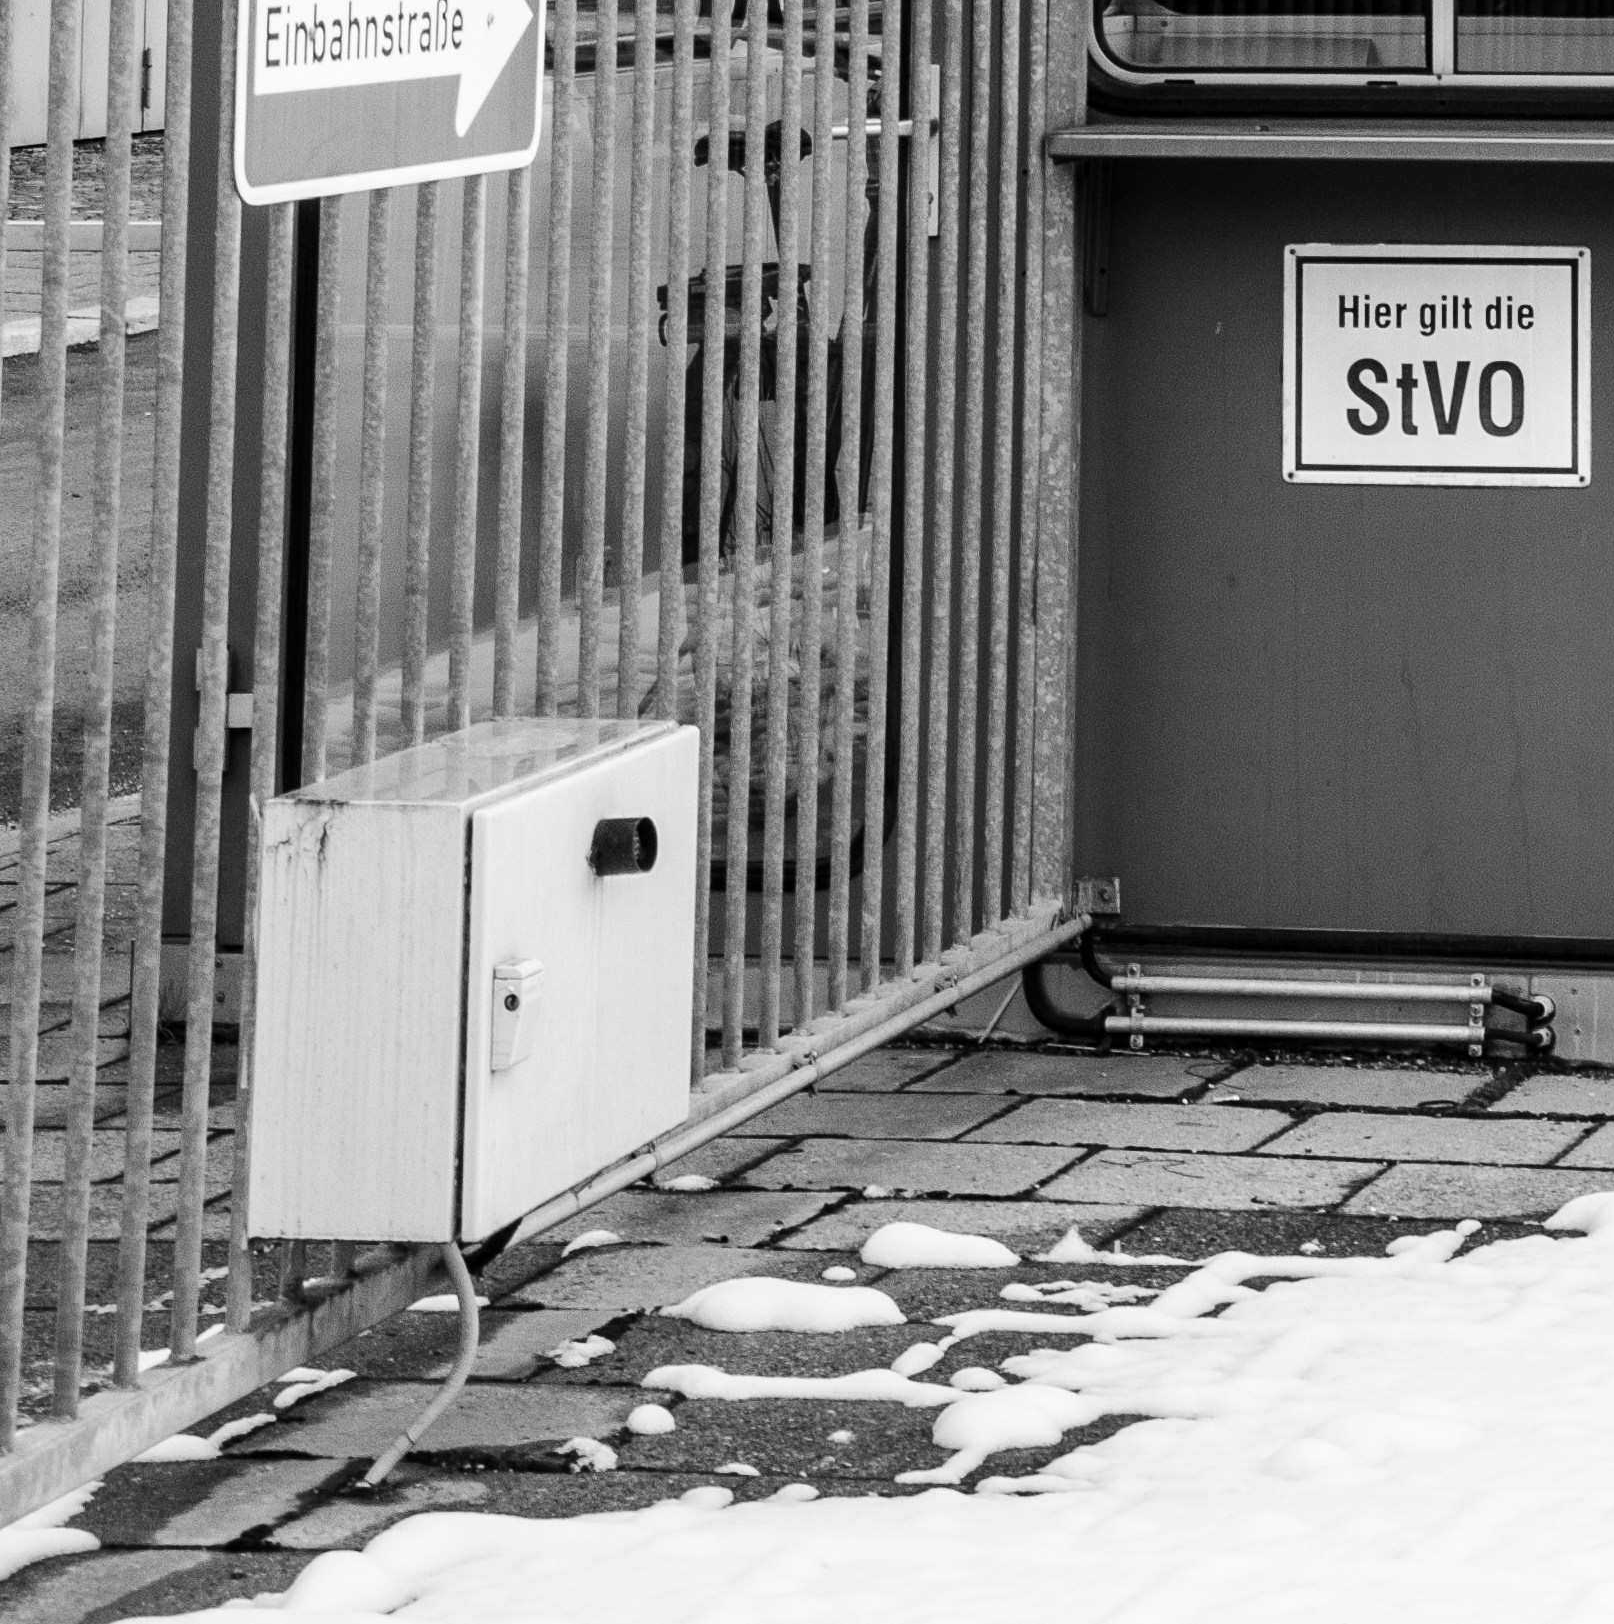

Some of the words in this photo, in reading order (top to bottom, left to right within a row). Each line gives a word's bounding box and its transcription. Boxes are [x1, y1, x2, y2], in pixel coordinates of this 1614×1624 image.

[1339, 295, 1407, 328] Hier
[1420, 295, 1472, 336] gilt
[1486, 296, 1534, 330] die
[1347, 358, 1524, 437] StVO
